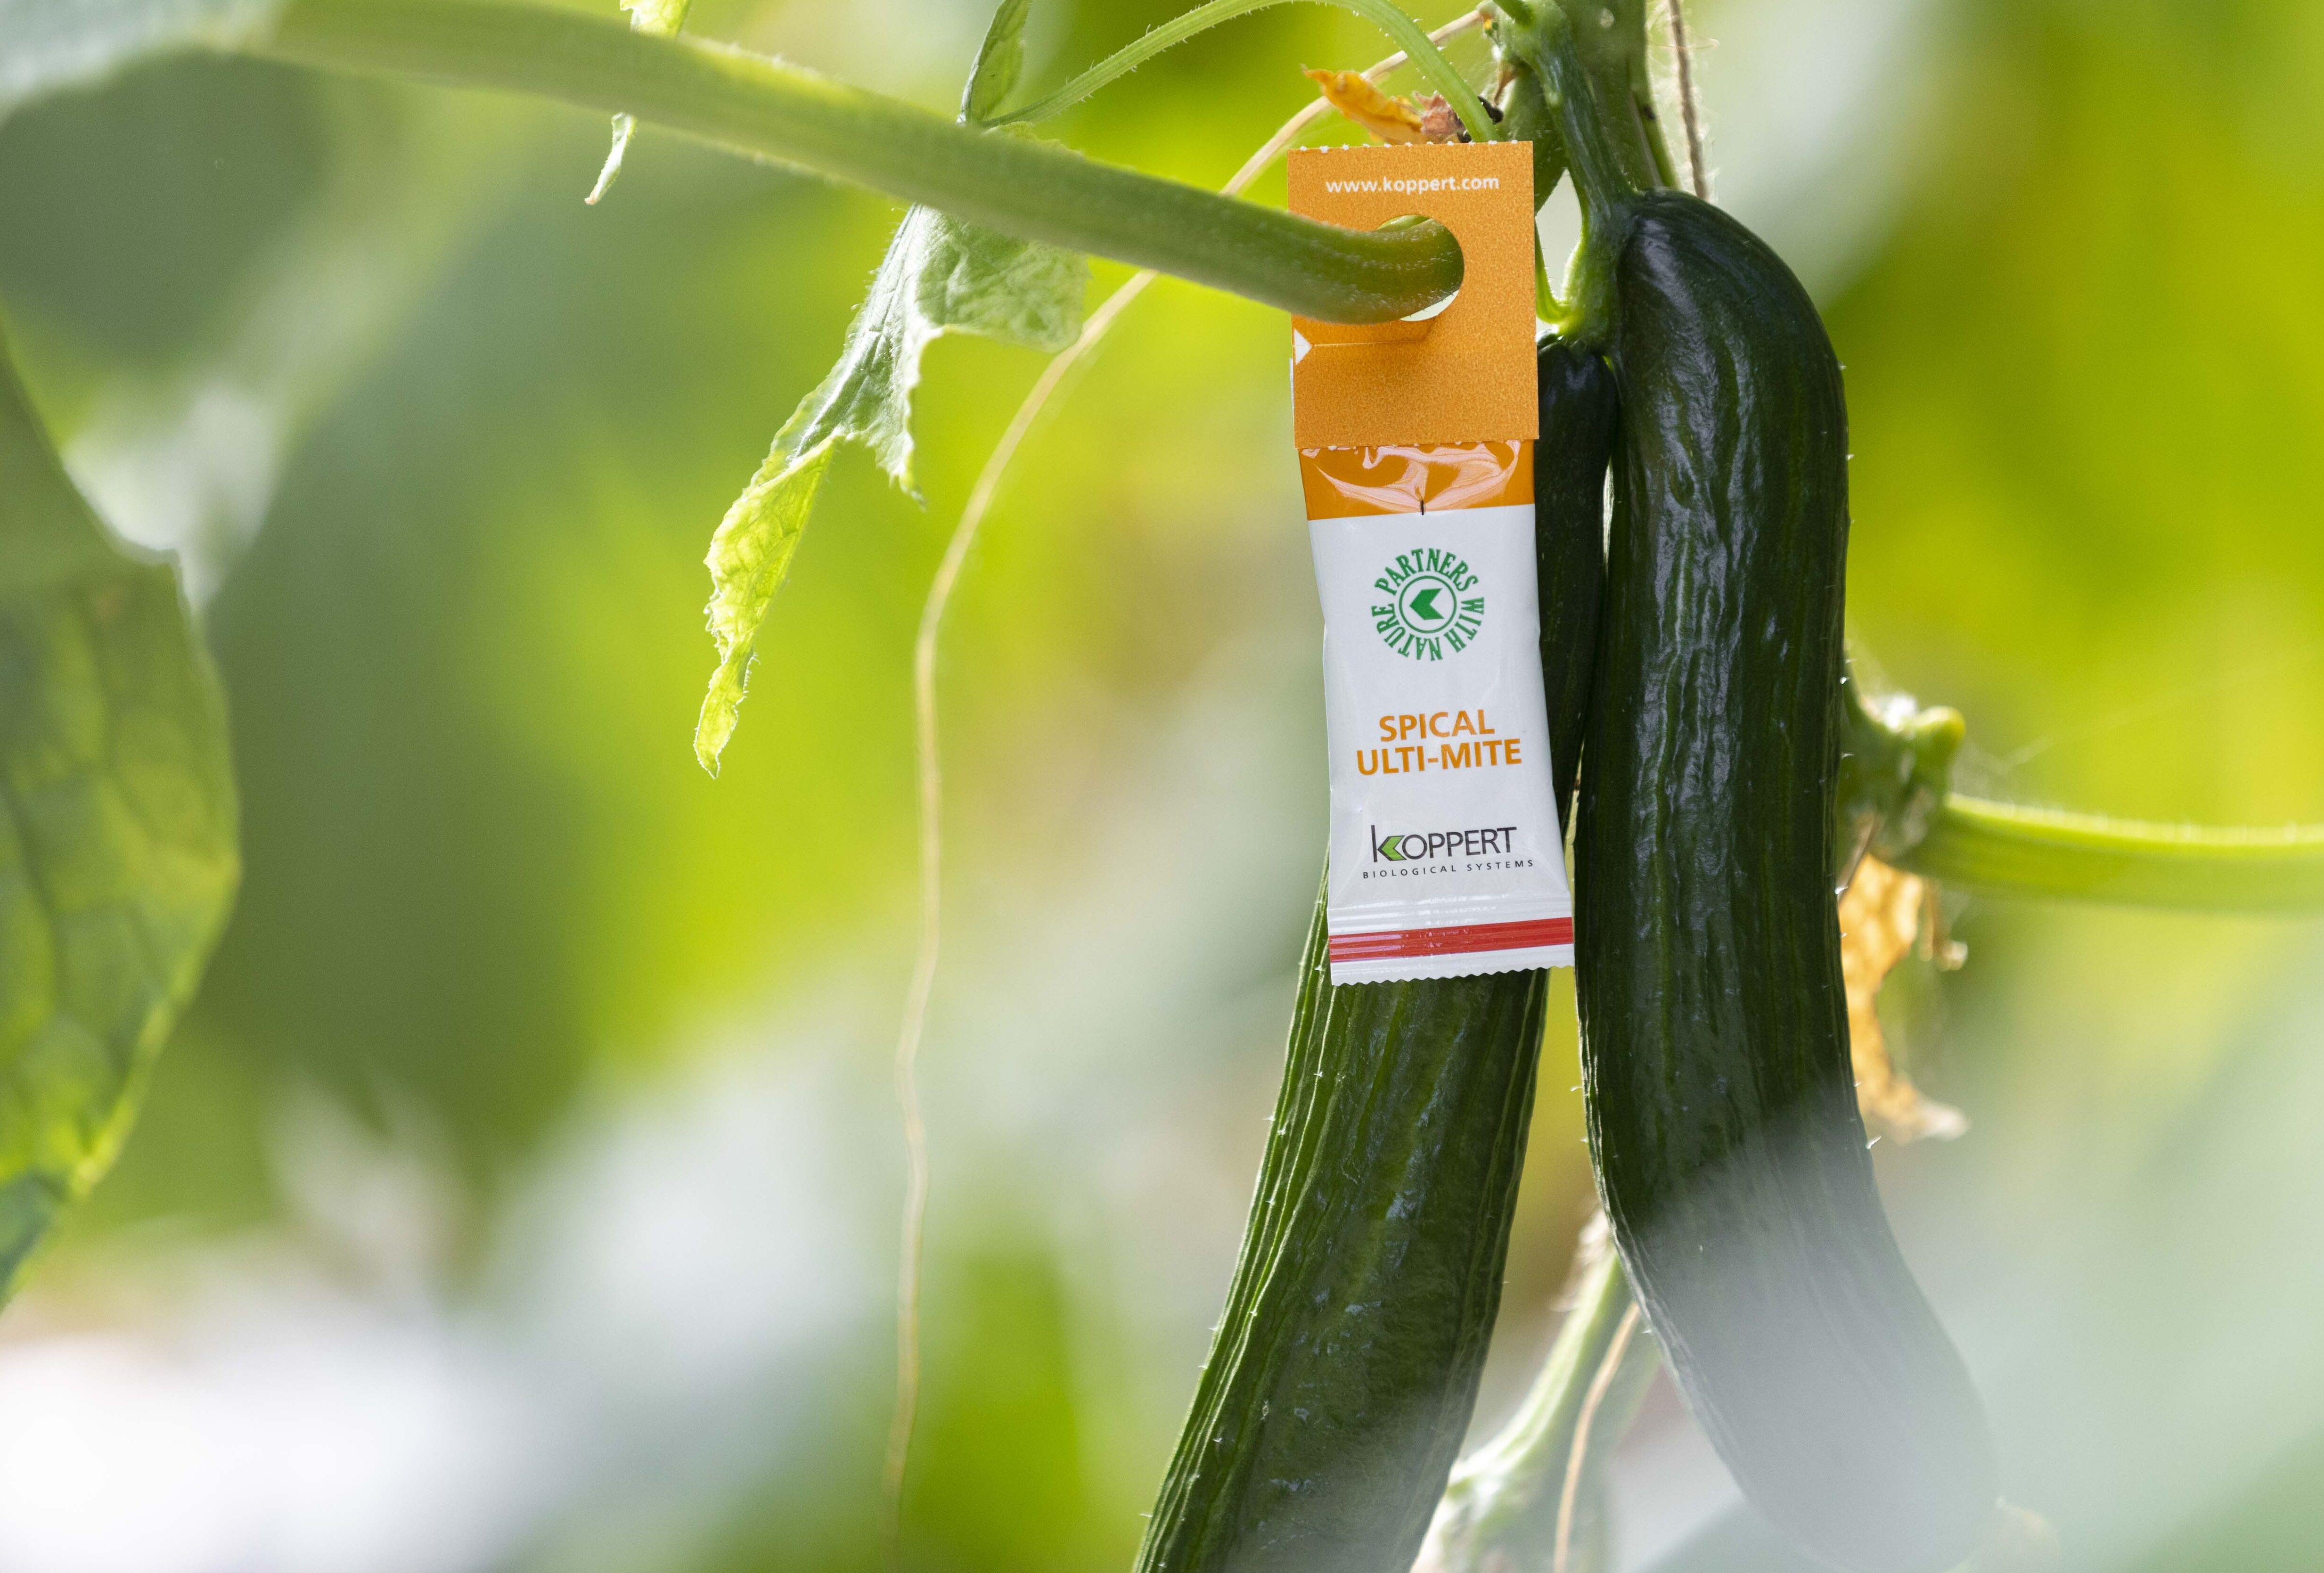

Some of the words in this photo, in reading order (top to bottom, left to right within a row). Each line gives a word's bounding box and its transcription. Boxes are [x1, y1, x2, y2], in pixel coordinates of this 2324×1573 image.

[1326, 176, 1500, 195] www.koppert.com
[1374, 548, 1479, 596] PARTNERS
[1371, 603, 1443, 662] NATURE
[1443, 596, 1485, 653] WITH
[1379, 709, 1495, 742] SPICAL
[1356, 738, 1522, 776] ULTI-MITE
[1363, 864, 1457, 879] BIOLOGICAL
[1466, 859, 1534, 872] SYSTEMS
